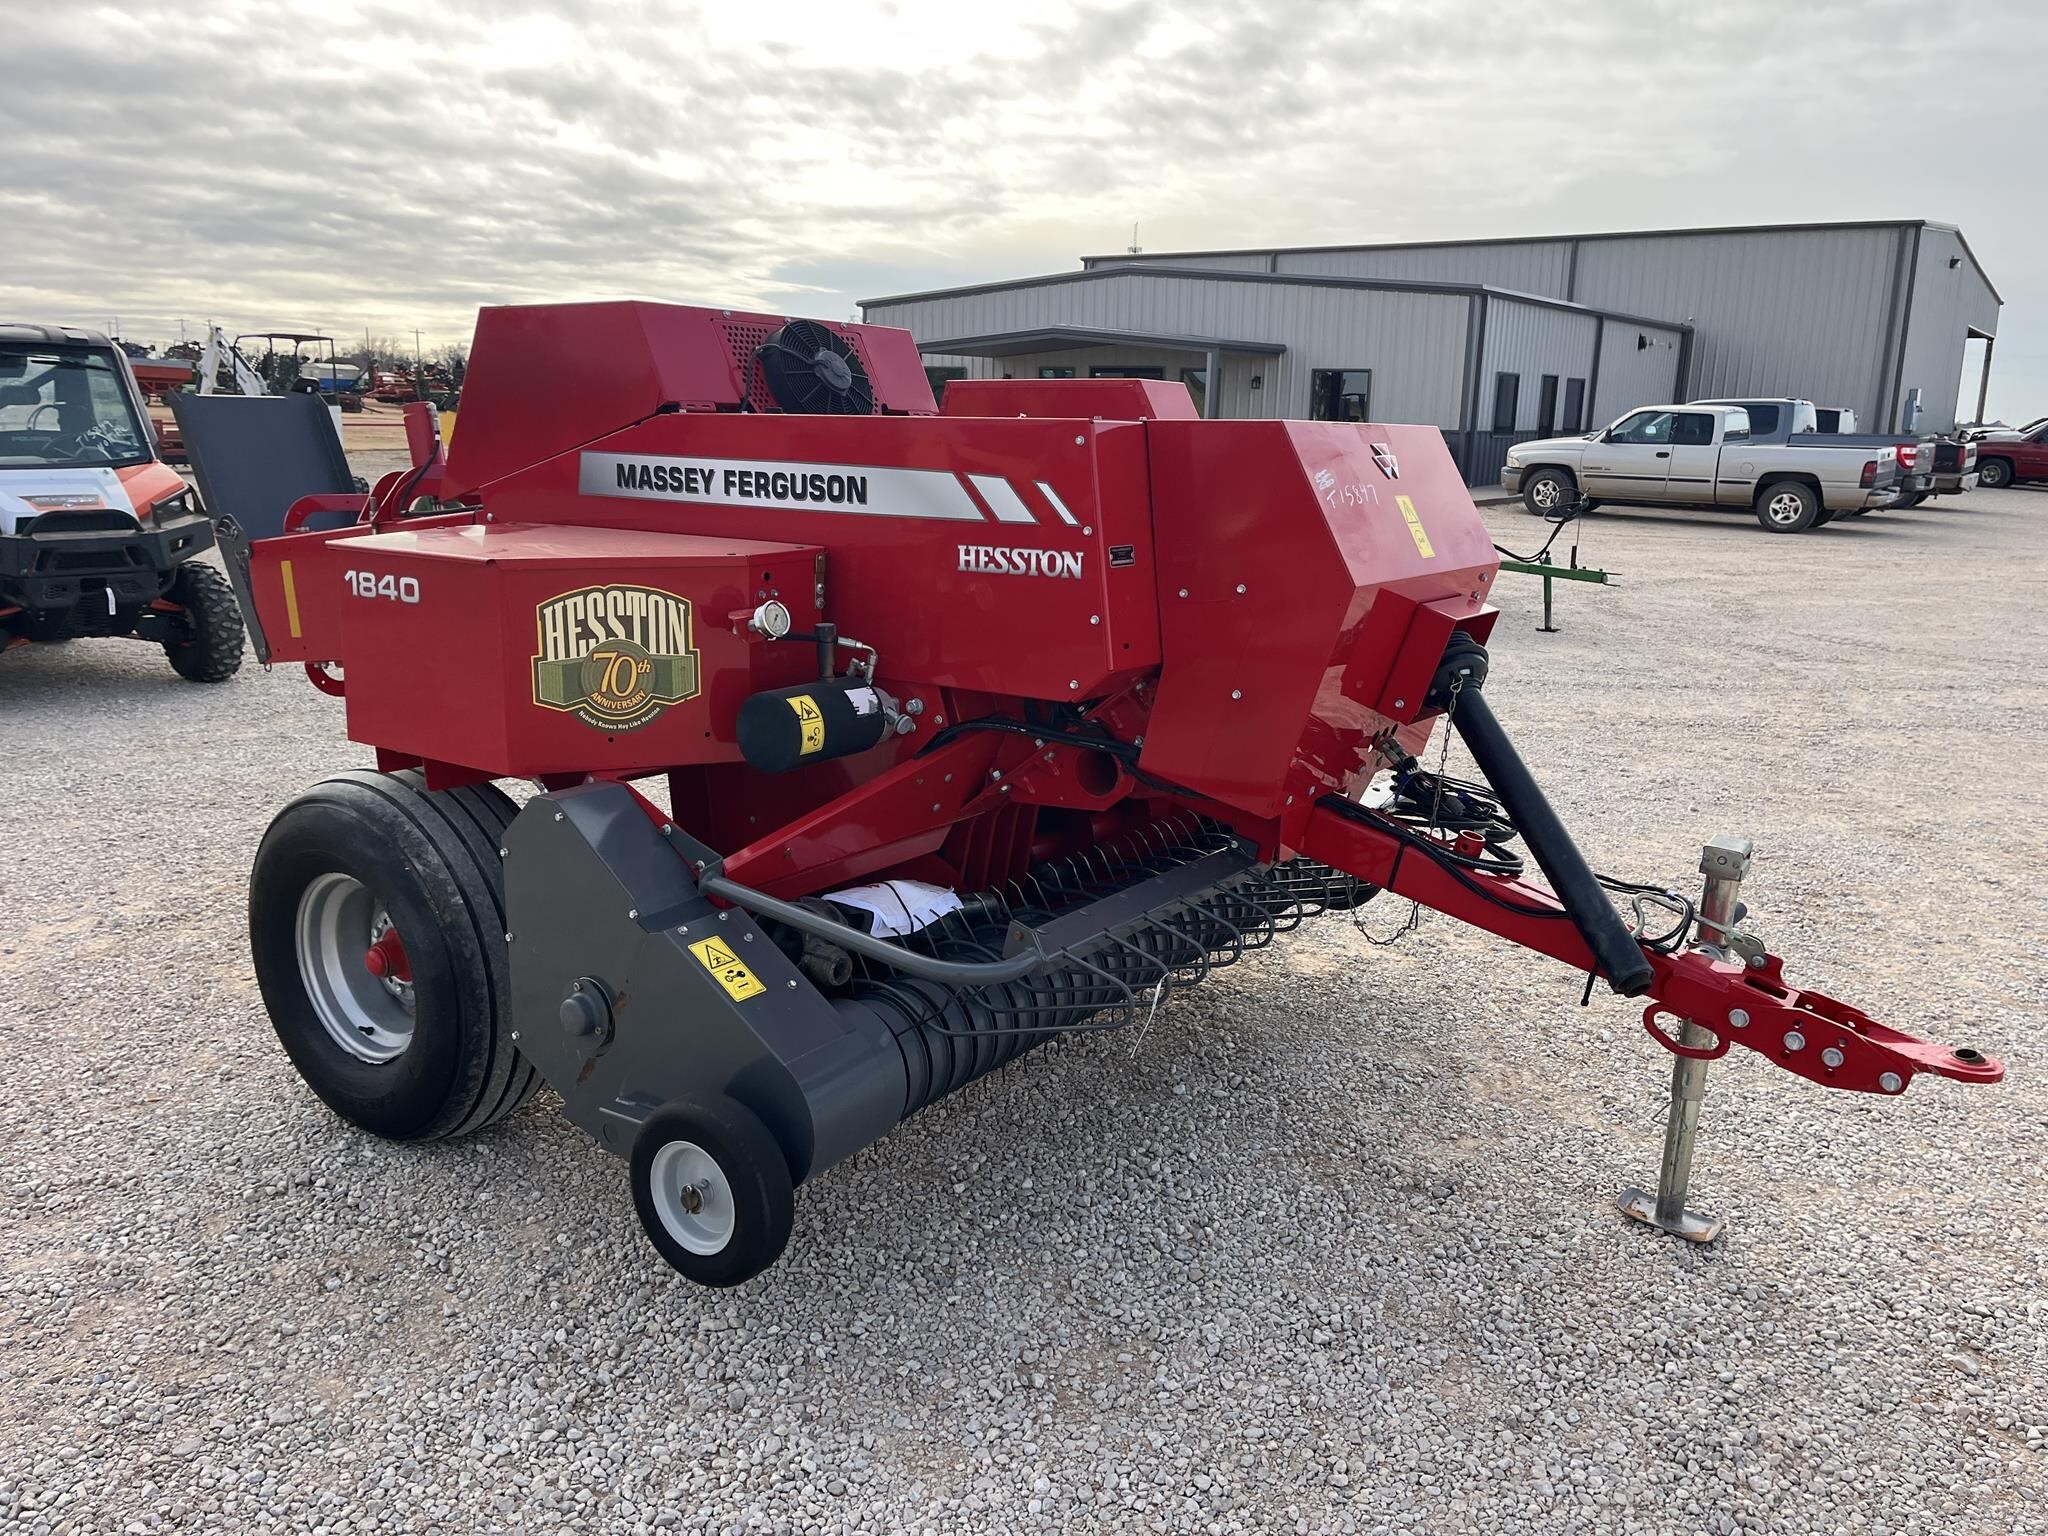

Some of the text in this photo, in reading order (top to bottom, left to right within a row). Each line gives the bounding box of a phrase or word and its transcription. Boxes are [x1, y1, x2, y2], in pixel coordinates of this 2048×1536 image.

[616, 463, 868, 505] MASSEY FERGUSON
[957, 545, 1084, 580] HESSTON
[344, 570, 420, 604] 1840
[543, 590, 686, 662] HESSTON
[592, 651, 651, 697] 70th
[590, 690, 646, 710] ANNIVERSARY
[578, 710, 597, 726] Nobody
[597, 722, 617, 730] Knows
[629, 718, 641, 728] Like
[640, 707, 660, 724] Hesston
